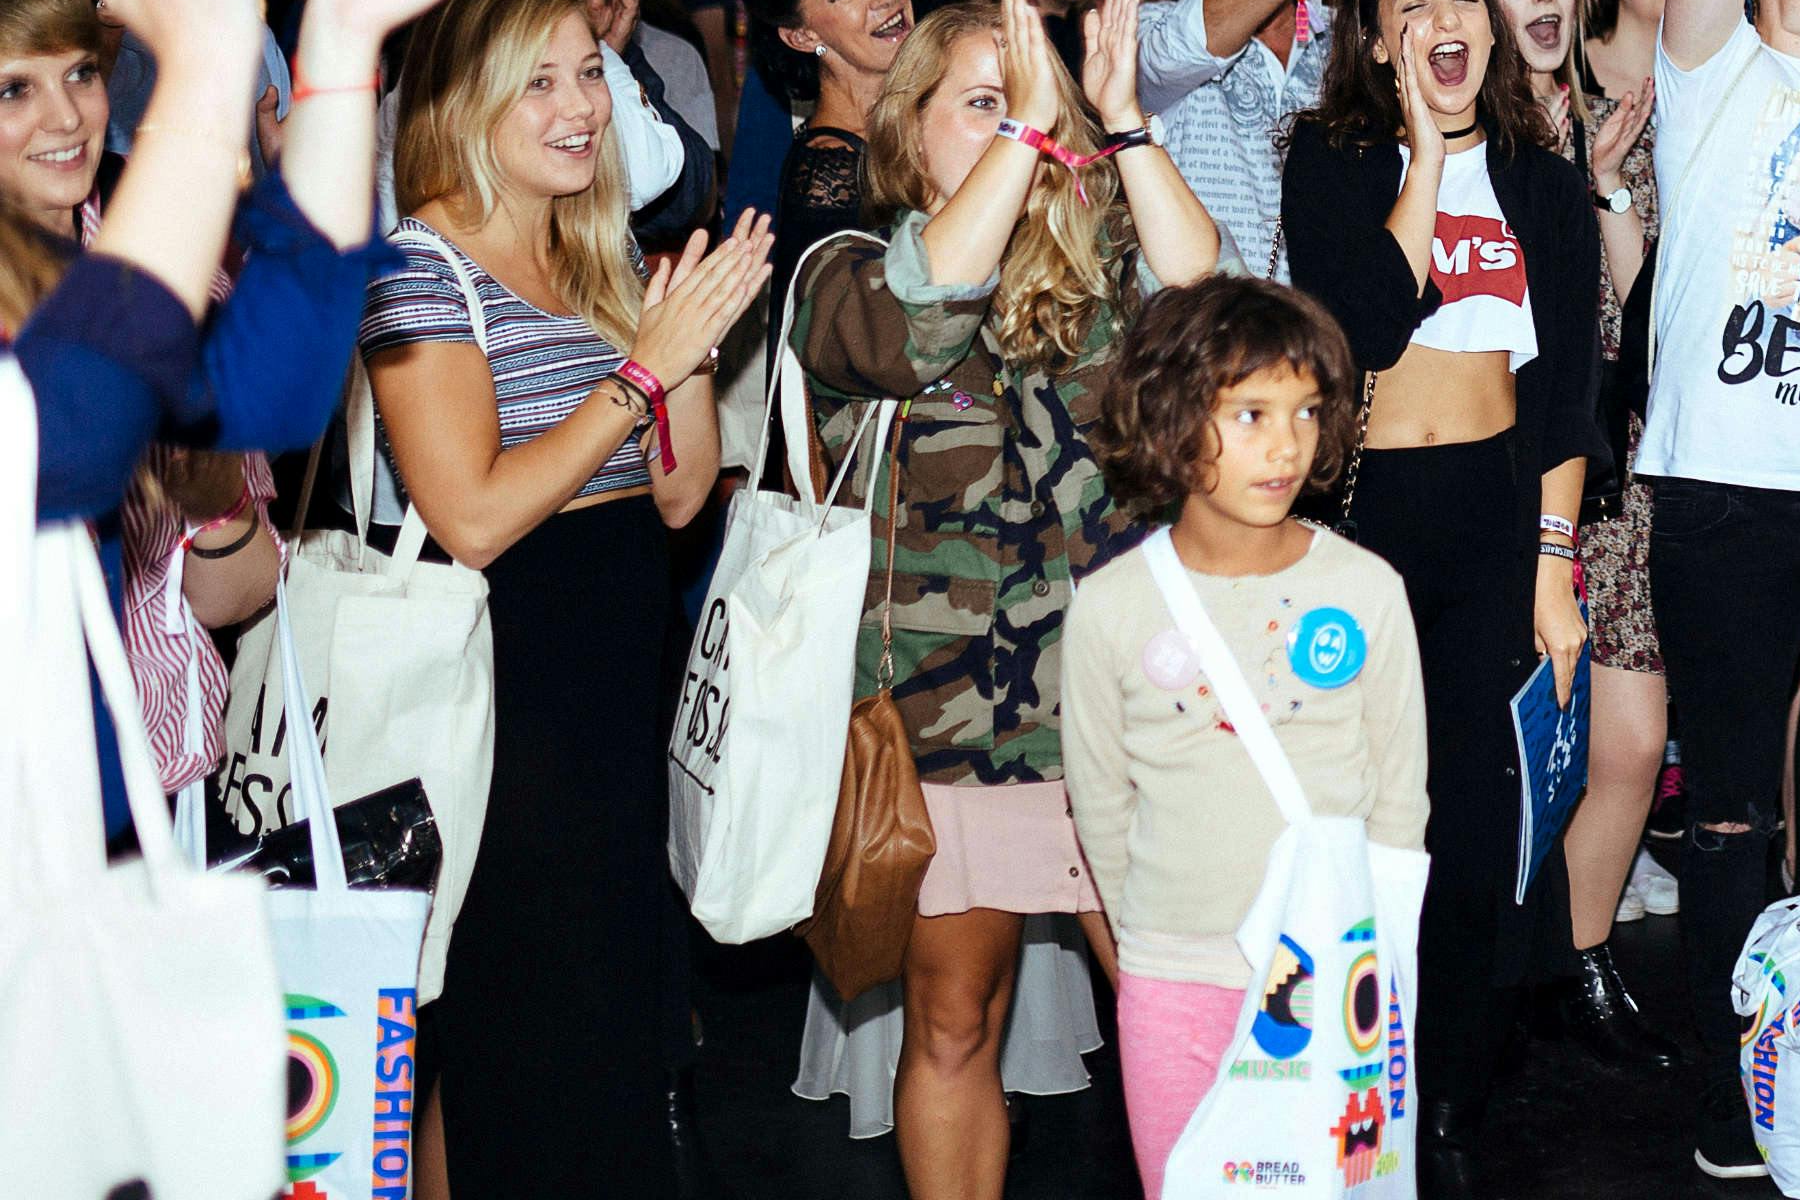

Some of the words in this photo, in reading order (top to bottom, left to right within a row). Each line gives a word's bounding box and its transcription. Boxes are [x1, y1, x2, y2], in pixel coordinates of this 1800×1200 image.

[1735, 269, 1786, 298] SAVE
[1228, 1059, 1312, 1082] MUSIC
[1256, 1161, 1300, 1174] BREAD
[1255, 1173, 1306, 1186] BUTTER
